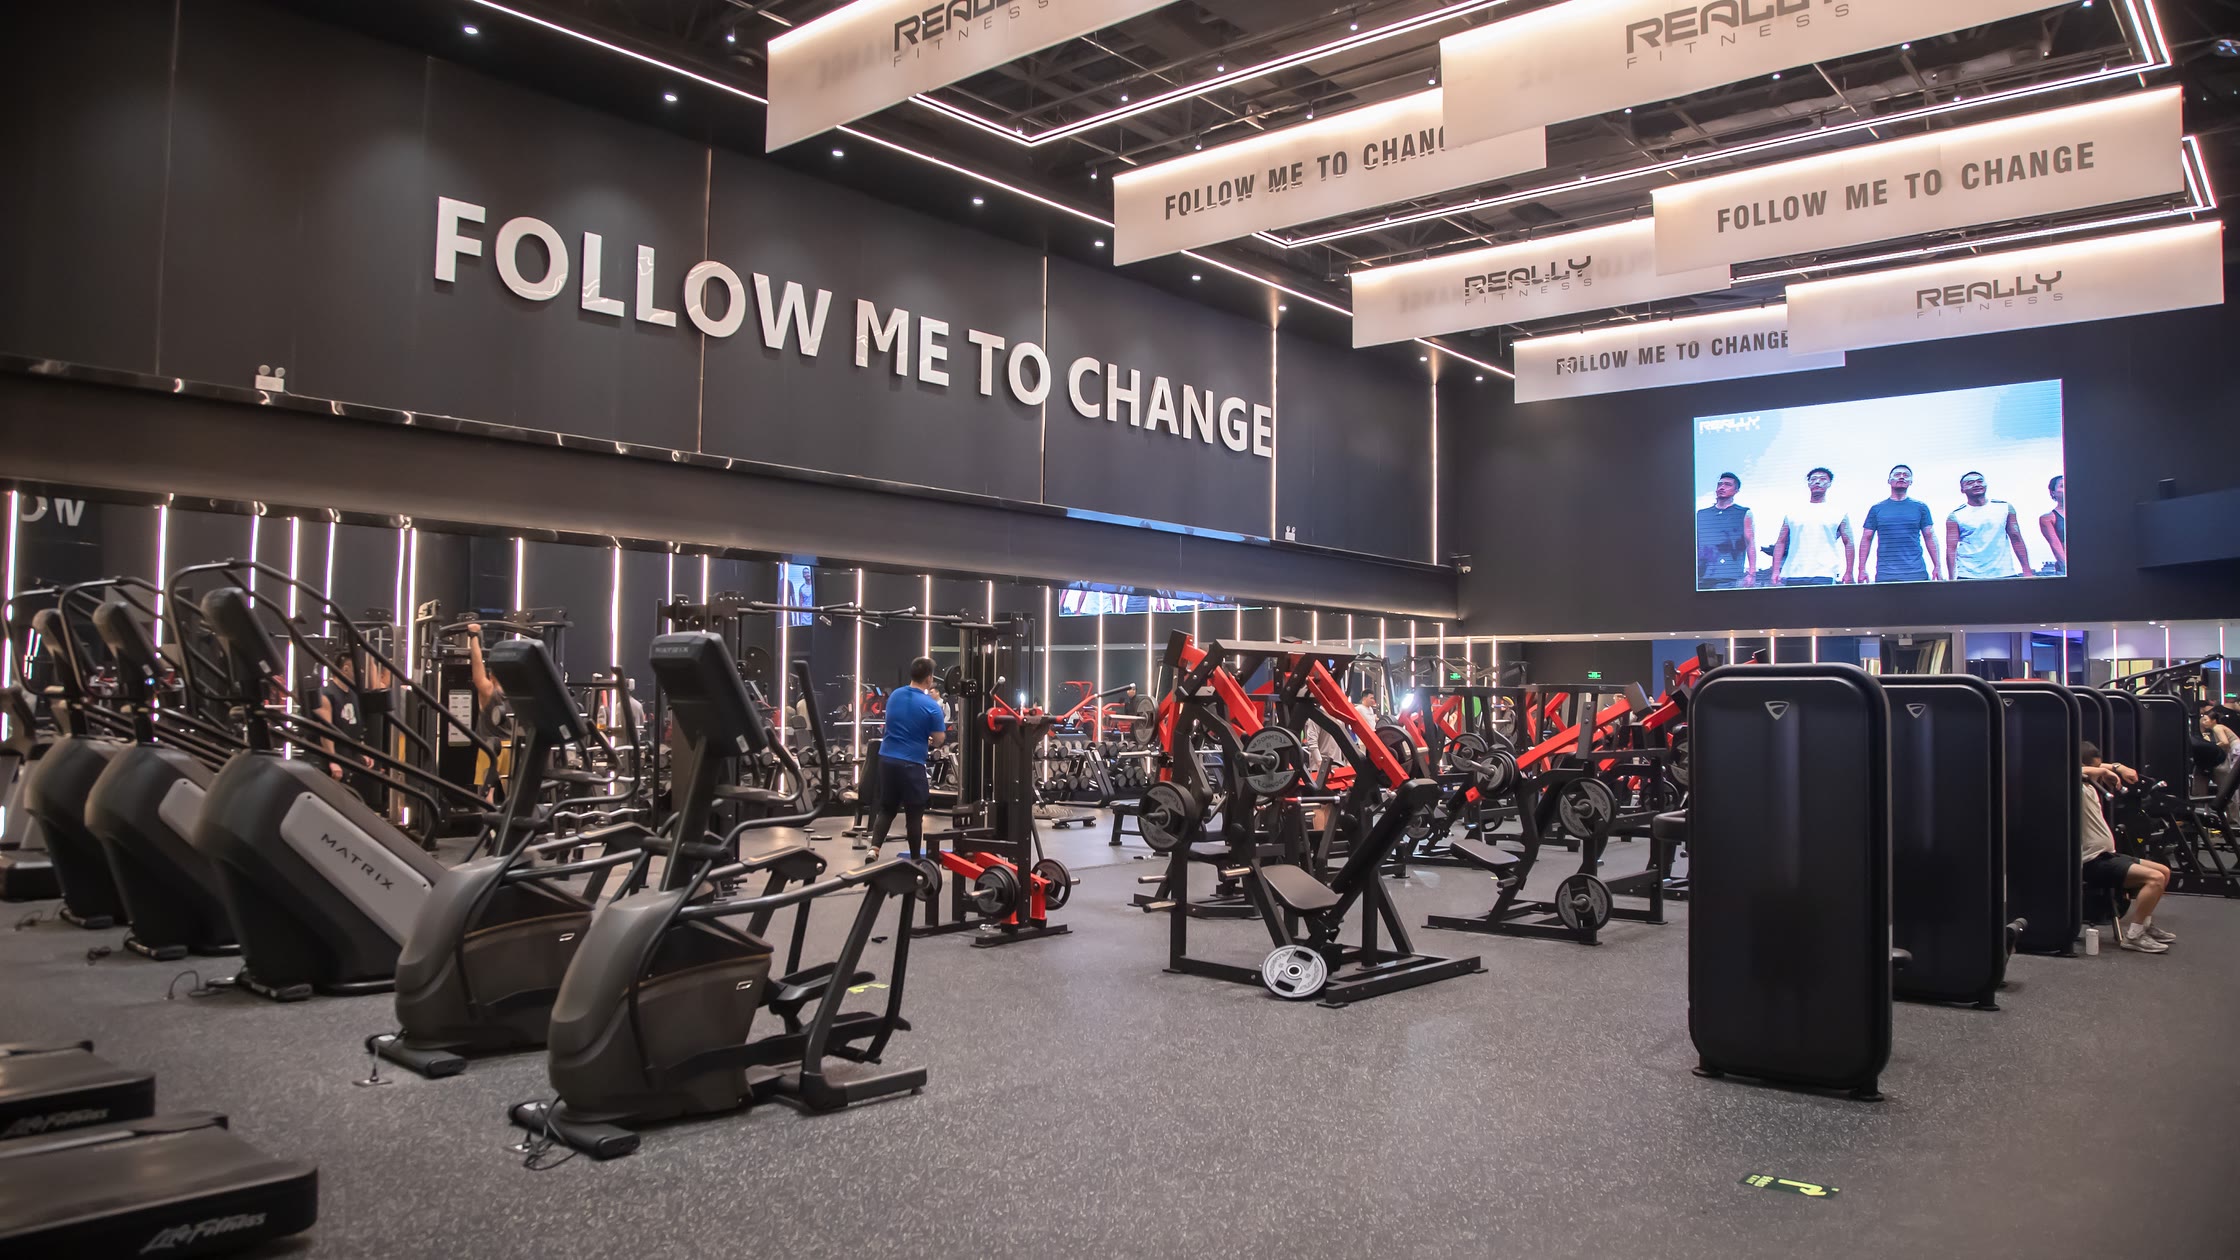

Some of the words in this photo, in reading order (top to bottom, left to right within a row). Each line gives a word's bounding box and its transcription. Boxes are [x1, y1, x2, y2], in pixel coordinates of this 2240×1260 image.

[893, 0, 1049, 67] FITNESS
[894, 0, 1012, 52] REAL
[1626, 0, 1833, 54] REALL
[1626, 4, 1849, 69] FITNESS
[1165, 174, 1255, 220] FOLLOW
[1268, 162, 1303, 193] ME
[1317, 151, 1348, 181] TO
[1364, 125, 1445, 170] CHAN
[1717, 191, 1827, 232] FOLLOW
[1845, 179, 1888, 211] ME
[1905, 169, 1941, 199] TO
[1961, 141, 2095, 190] CHANGE
[1464, 278, 1592, 306] FITNESS
[1465, 255, 1591, 297] REALLY
[1916, 271, 2062, 309] REALLY
[435, 196, 832, 357] FOLLOW
[855, 299, 949, 387] ME
[968, 328, 1051, 406] TO
[1068, 356, 1274, 459] CHANGE
[1916, 292, 2063, 319] FITNESS
[1556, 350, 1628, 375] FOLLOW
[1638, 345, 1665, 366] ME
[1676, 341, 1699, 361] TO
[1711, 330, 1788, 356] CHANGE
[320, 833, 395, 891] MATRIX
